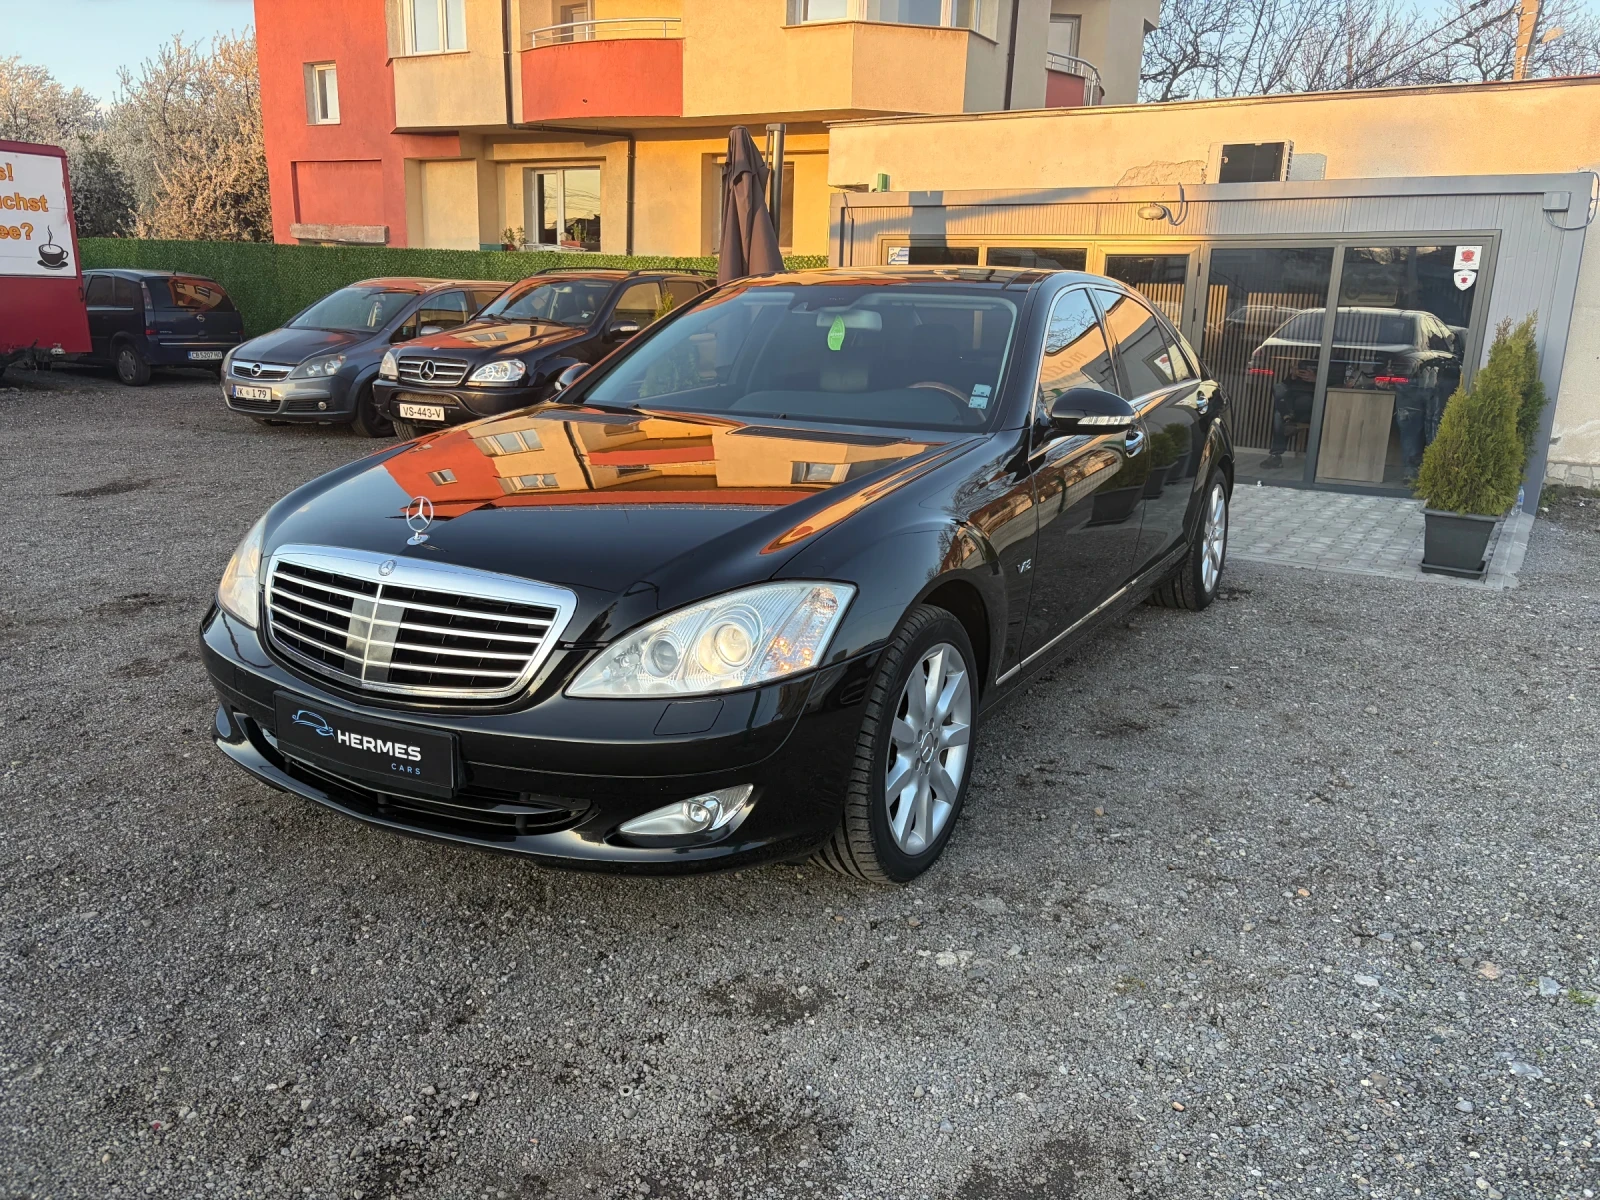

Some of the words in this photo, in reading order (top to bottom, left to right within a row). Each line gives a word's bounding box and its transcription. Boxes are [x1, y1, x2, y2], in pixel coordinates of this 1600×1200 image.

[0, 192, 49, 212] chst
[402, 406, 442, 419] VS-443-V
[337, 729, 422, 762] HERMES
[391, 762, 421, 775] CARS
